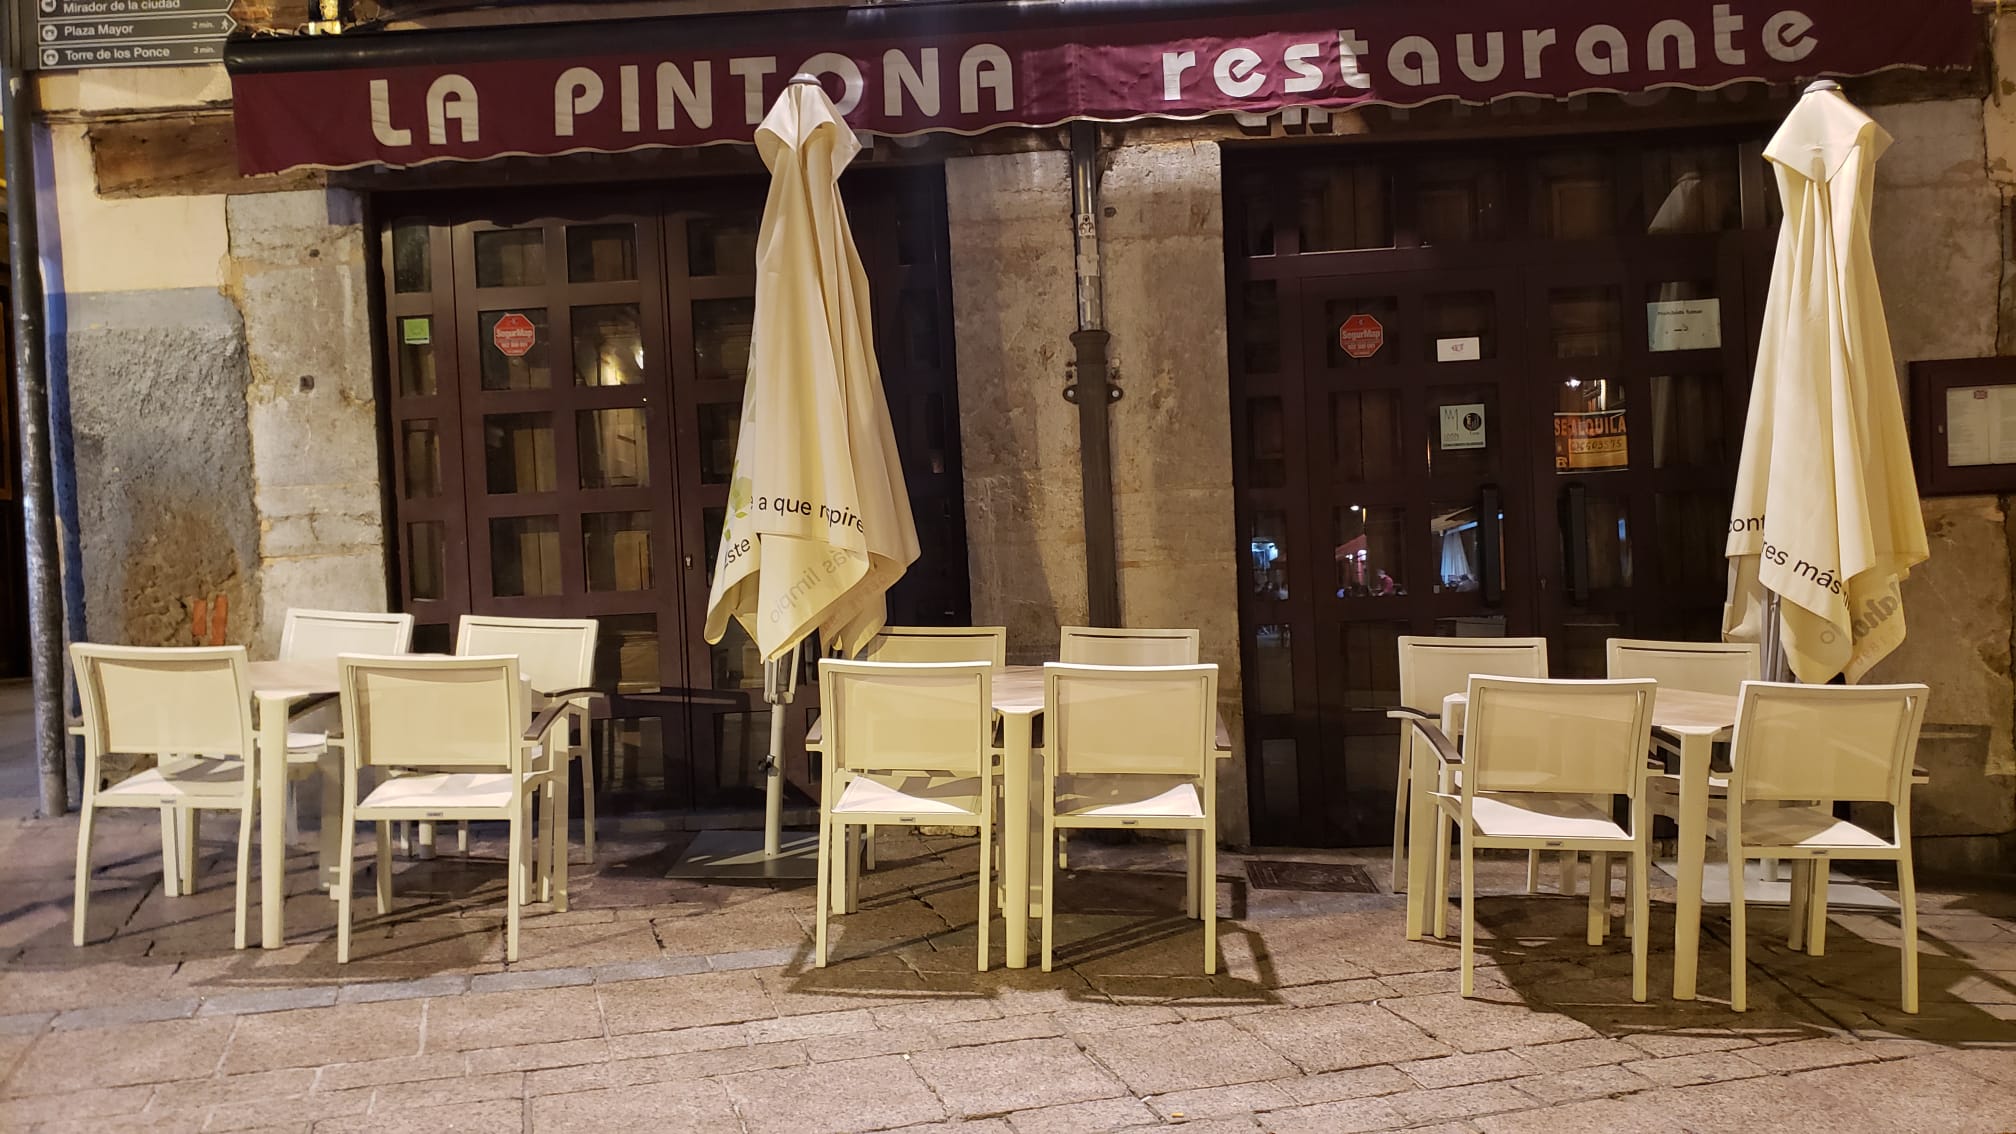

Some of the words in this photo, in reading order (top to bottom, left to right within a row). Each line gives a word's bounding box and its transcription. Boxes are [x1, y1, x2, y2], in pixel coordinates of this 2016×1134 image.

[63, 2, 108, 14] Mirador
[110, 1, 125, 11] de
[128, 0, 139, 10] la
[141, 0, 181, 9] ciudad
[64, 25, 95, 36] Plaza
[98, 24, 134, 36] Mayor
[65, 50, 94, 61] Torre
[96, 48, 111, 60] de
[113, 48, 131, 59] los
[133, 47, 170, 58] Ponce
[370, 74, 479, 146] LA
[555, 43, 1014, 136] PINTONA
[1162, 4, 1818, 100] restaurante
[1554, 417, 1568, 437] SE
[1569, 415, 1626, 436] ALQUILA
[758, 496, 767, 510] a
[773, 497, 812, 517] que
[1729, 514, 1765, 533] ont
[1793, 559, 1842, 595] más
